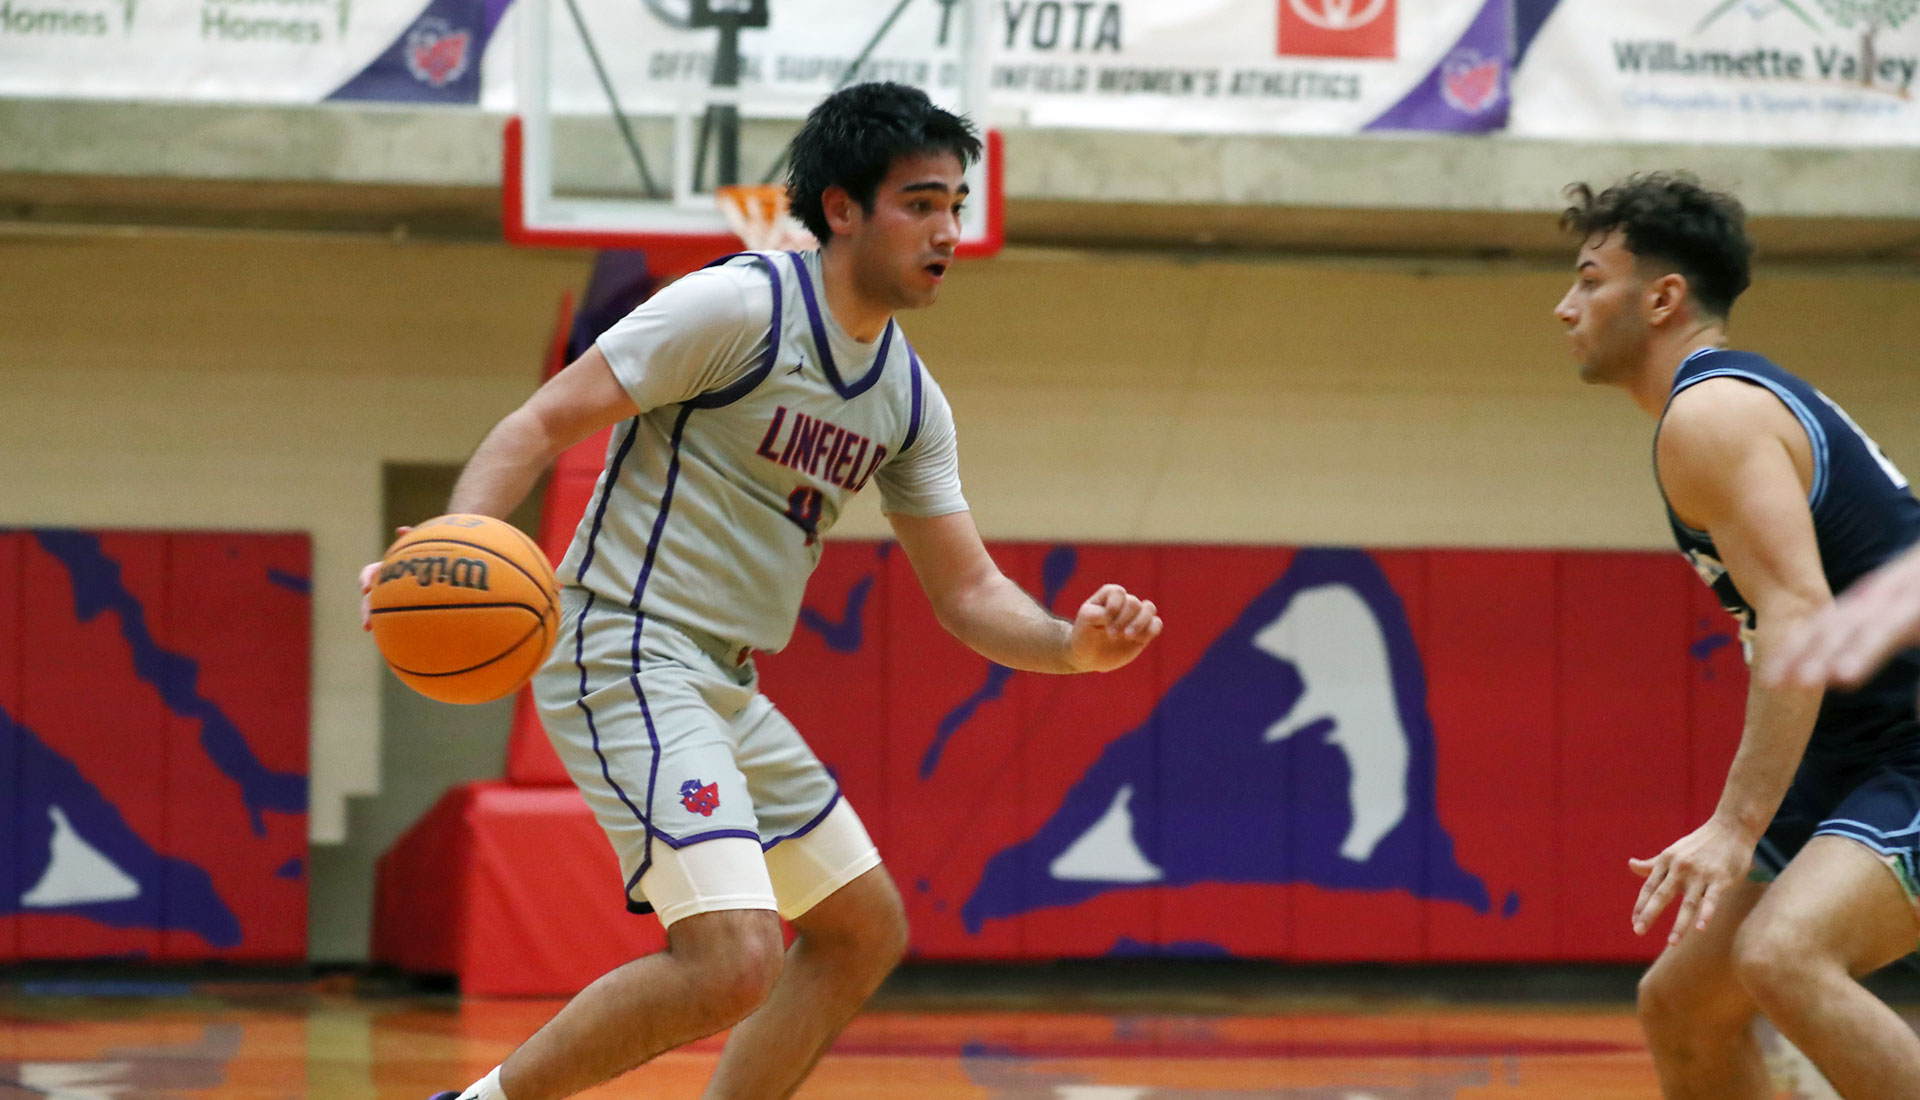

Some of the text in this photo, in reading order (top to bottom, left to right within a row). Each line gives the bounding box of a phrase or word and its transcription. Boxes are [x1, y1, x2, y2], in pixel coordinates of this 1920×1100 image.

[201, 7, 322, 45] Homes
[933, 0, 1122, 50] TYOTA
[649, 50, 762, 82] OFFIAL
[991, 64, 1088, 93] INFIELD
[1098, 67, 1219, 97] WOMEN'S
[1228, 70, 1362, 99] ATHLETICS
[1612, 38, 1803, 77] Willamette
[756, 405, 887, 493] LINFIELD
[380, 556, 491, 592] Wilson
